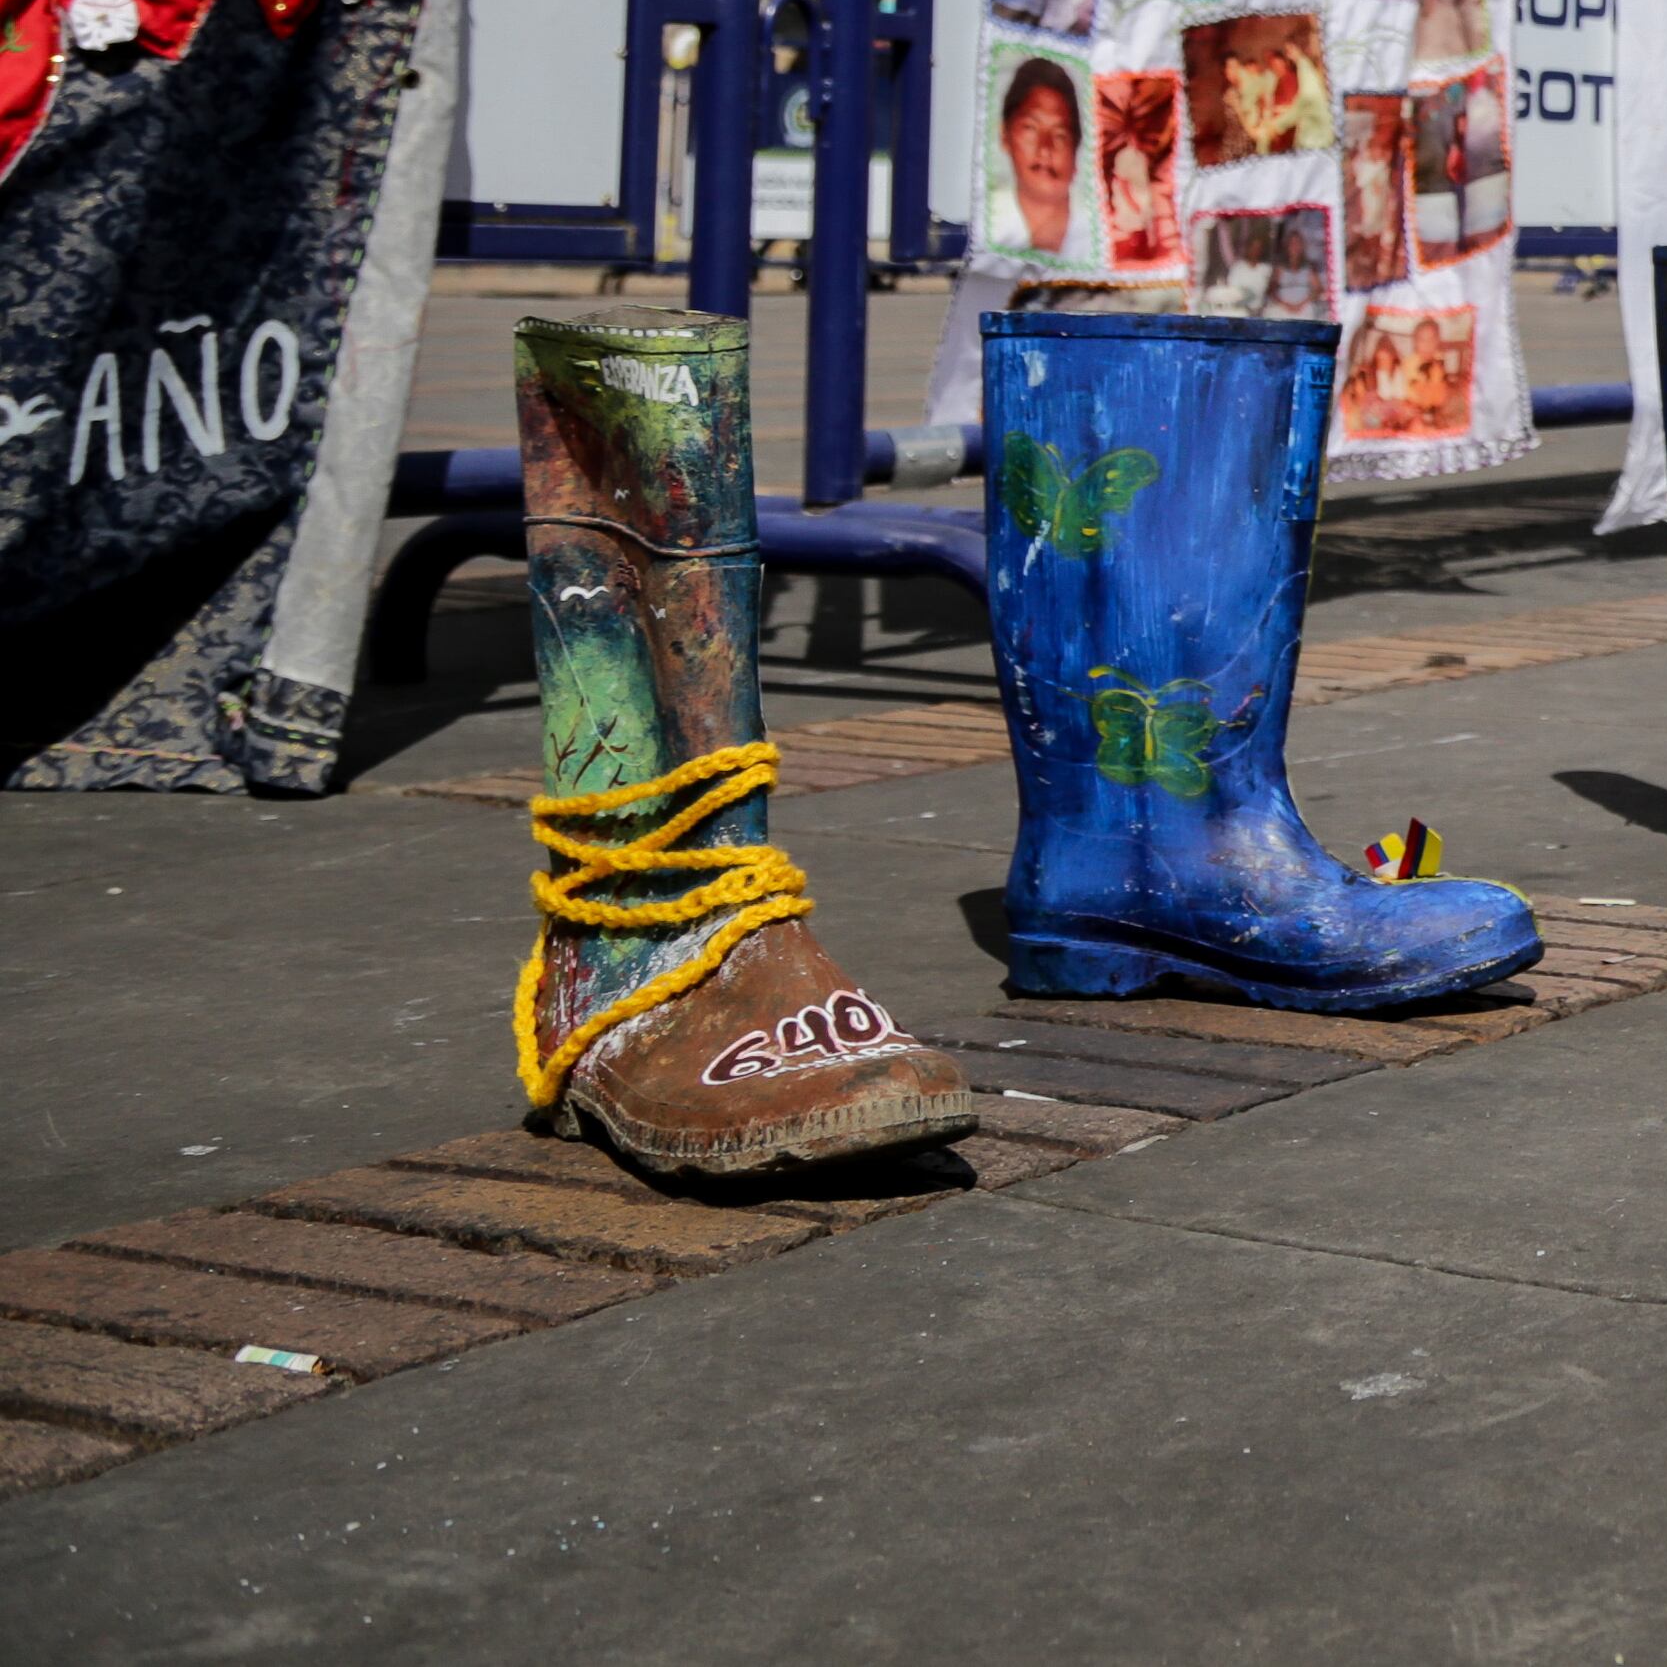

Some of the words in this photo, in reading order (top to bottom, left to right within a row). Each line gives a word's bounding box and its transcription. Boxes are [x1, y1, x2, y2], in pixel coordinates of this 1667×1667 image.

[69, 314, 299, 486] AÑO
[601, 354, 699, 407] ESPERANZA
[702, 989, 914, 1086] 640
